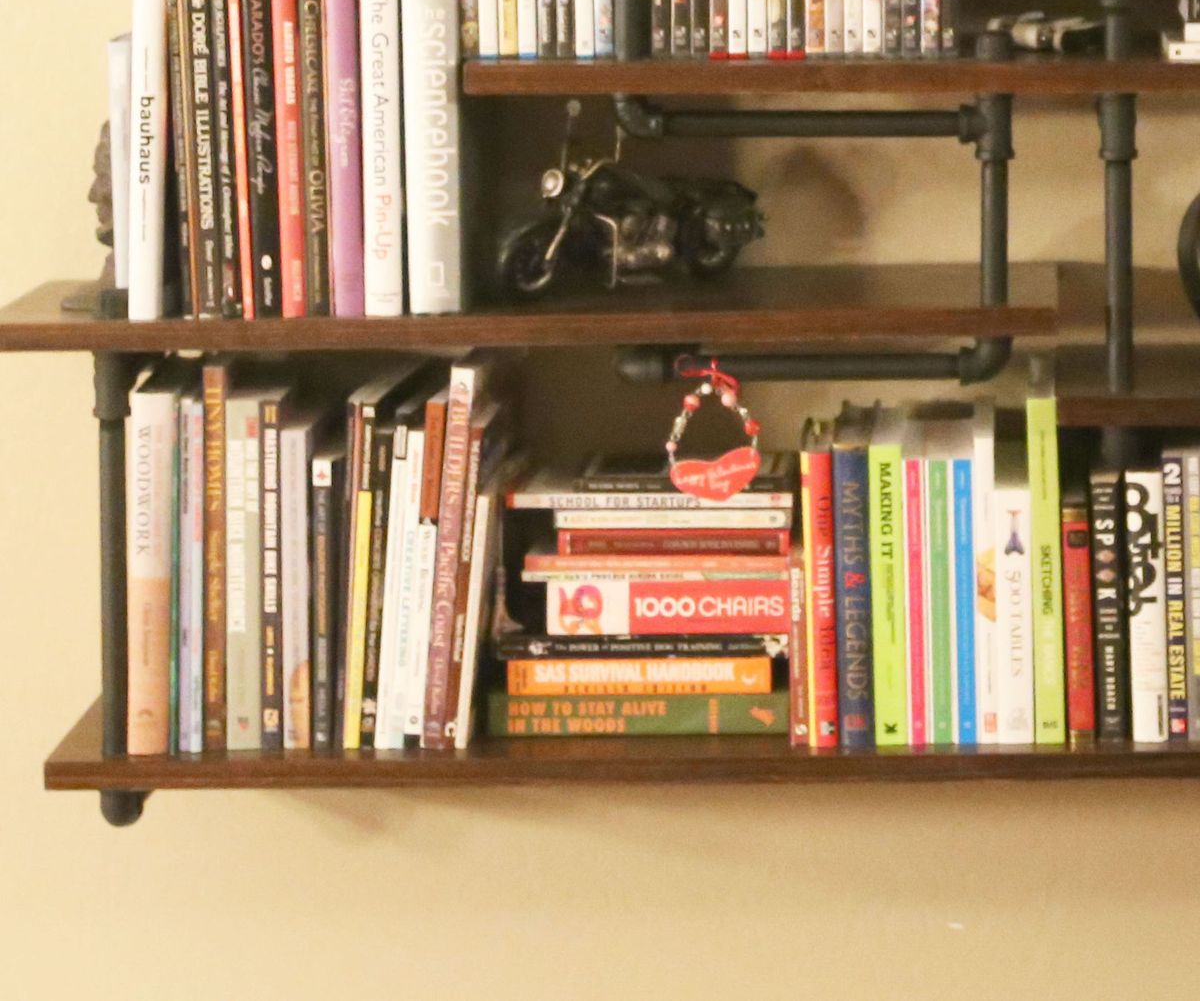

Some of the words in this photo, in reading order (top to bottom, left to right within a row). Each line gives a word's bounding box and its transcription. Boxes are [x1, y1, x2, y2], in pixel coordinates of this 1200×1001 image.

[192, 11, 210, 56] DORÉ
[371, 32, 390, 87] Great
[193, 57, 209, 105] BIBLE
[139, 96, 155, 185] bauhaus
[372, 95, 391, 187] American
[421, 20, 457, 227] sciencebook
[195, 109, 214, 230] ILLUSTRATIONS
[308, 168, 325, 234] OLIVIA
[371, 194, 392, 261] Pin-Up
[205, 387, 222, 432] TINY
[205, 437, 222, 512] HOMES
[448, 406, 468, 506] BUILDERS
[136, 425, 152, 557] WOODWORK
[548, 497, 599, 508] SCHOOL
[606, 497, 629, 507] FOR
[637, 496, 701, 508] STARTUPS
[878, 462, 894, 536] MAKING
[841, 480, 864, 566] MYTHS
[881, 541, 894, 560] IT
[1165, 504, 1183, 572] MILLION
[436, 542, 458, 598] Pacific
[811, 544, 834, 618] Simple
[843, 570, 867, 590] &
[1040, 544, 1054, 616] SKETCHING
[1166, 576, 1183, 595] IN
[434, 601, 454, 649] Coast
[633, 597, 695, 617] 1000
[698, 596, 784, 617] CHAIRS
[1168, 600, 1185, 641] REAL
[535, 664, 566, 683] SAS
[569, 663, 643, 683] SURVIVAL
[647, 662, 735, 682] HANDBOOK
[845, 595, 868, 702] LEGENDS
[1010, 612, 1025, 678] TABLES
[1104, 645, 1116, 673] MARY
[1168, 644, 1186, 700] ESTATE
[508, 701, 547, 716] HOW
[552, 701, 573, 716] TO
[579, 701, 616, 716] STAY
[622, 701, 667, 716] ALIVE
[508, 717, 527, 733] IN
[532, 717, 561, 733] THE
[567, 717, 625, 733] WOODS
